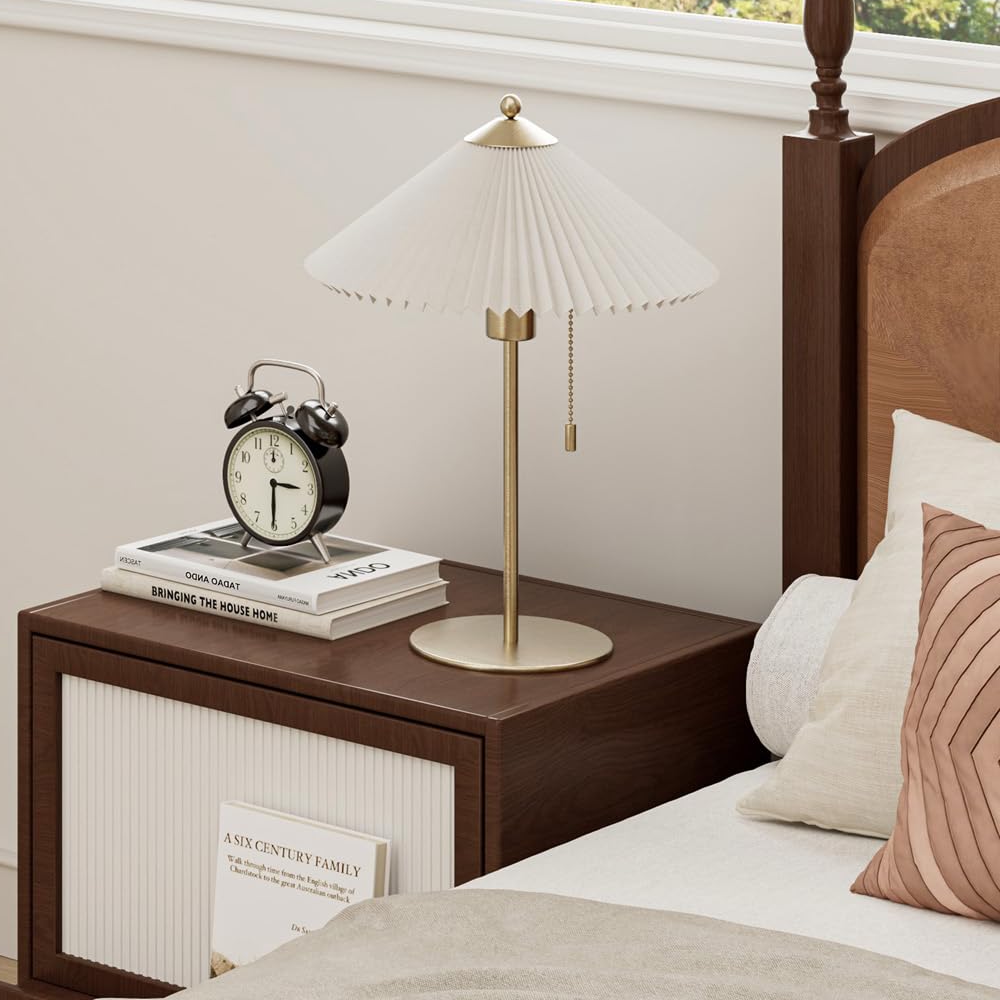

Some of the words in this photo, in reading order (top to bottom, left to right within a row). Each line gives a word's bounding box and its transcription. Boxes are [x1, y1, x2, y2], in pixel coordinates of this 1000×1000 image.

[254, 438, 262, 450] 11
[270, 434, 279, 447] 12
[290, 443, 293, 455] 1
[242, 450, 250, 464] 10
[302, 461, 308, 472] 2
[235, 471, 242, 483] 9
[307, 484, 314, 496] 3
[240, 492, 247, 505] 8
[254, 510, 260, 522] 7
[301, 504, 308, 516] 4
[271, 520, 278, 532] 6
[291, 517, 297, 529] 5
[152, 586, 197, 605] BRINGING
[199, 596, 217, 609] THE
[220, 601, 250, 616] HOUSE
[252, 608, 278, 623] HOME
[224, 832, 231, 844] A
[234, 834, 253, 849] SIX
[255, 840, 312, 864] CENTURY
[315, 856, 361, 877] FAMILY
[228, 855, 242, 864] Walk
[281, 870, 295, 879] from
[307, 876, 328, 887] English
[329, 883, 347, 894] village
[271, 876, 280, 884] the
[280, 881, 295, 889] great
